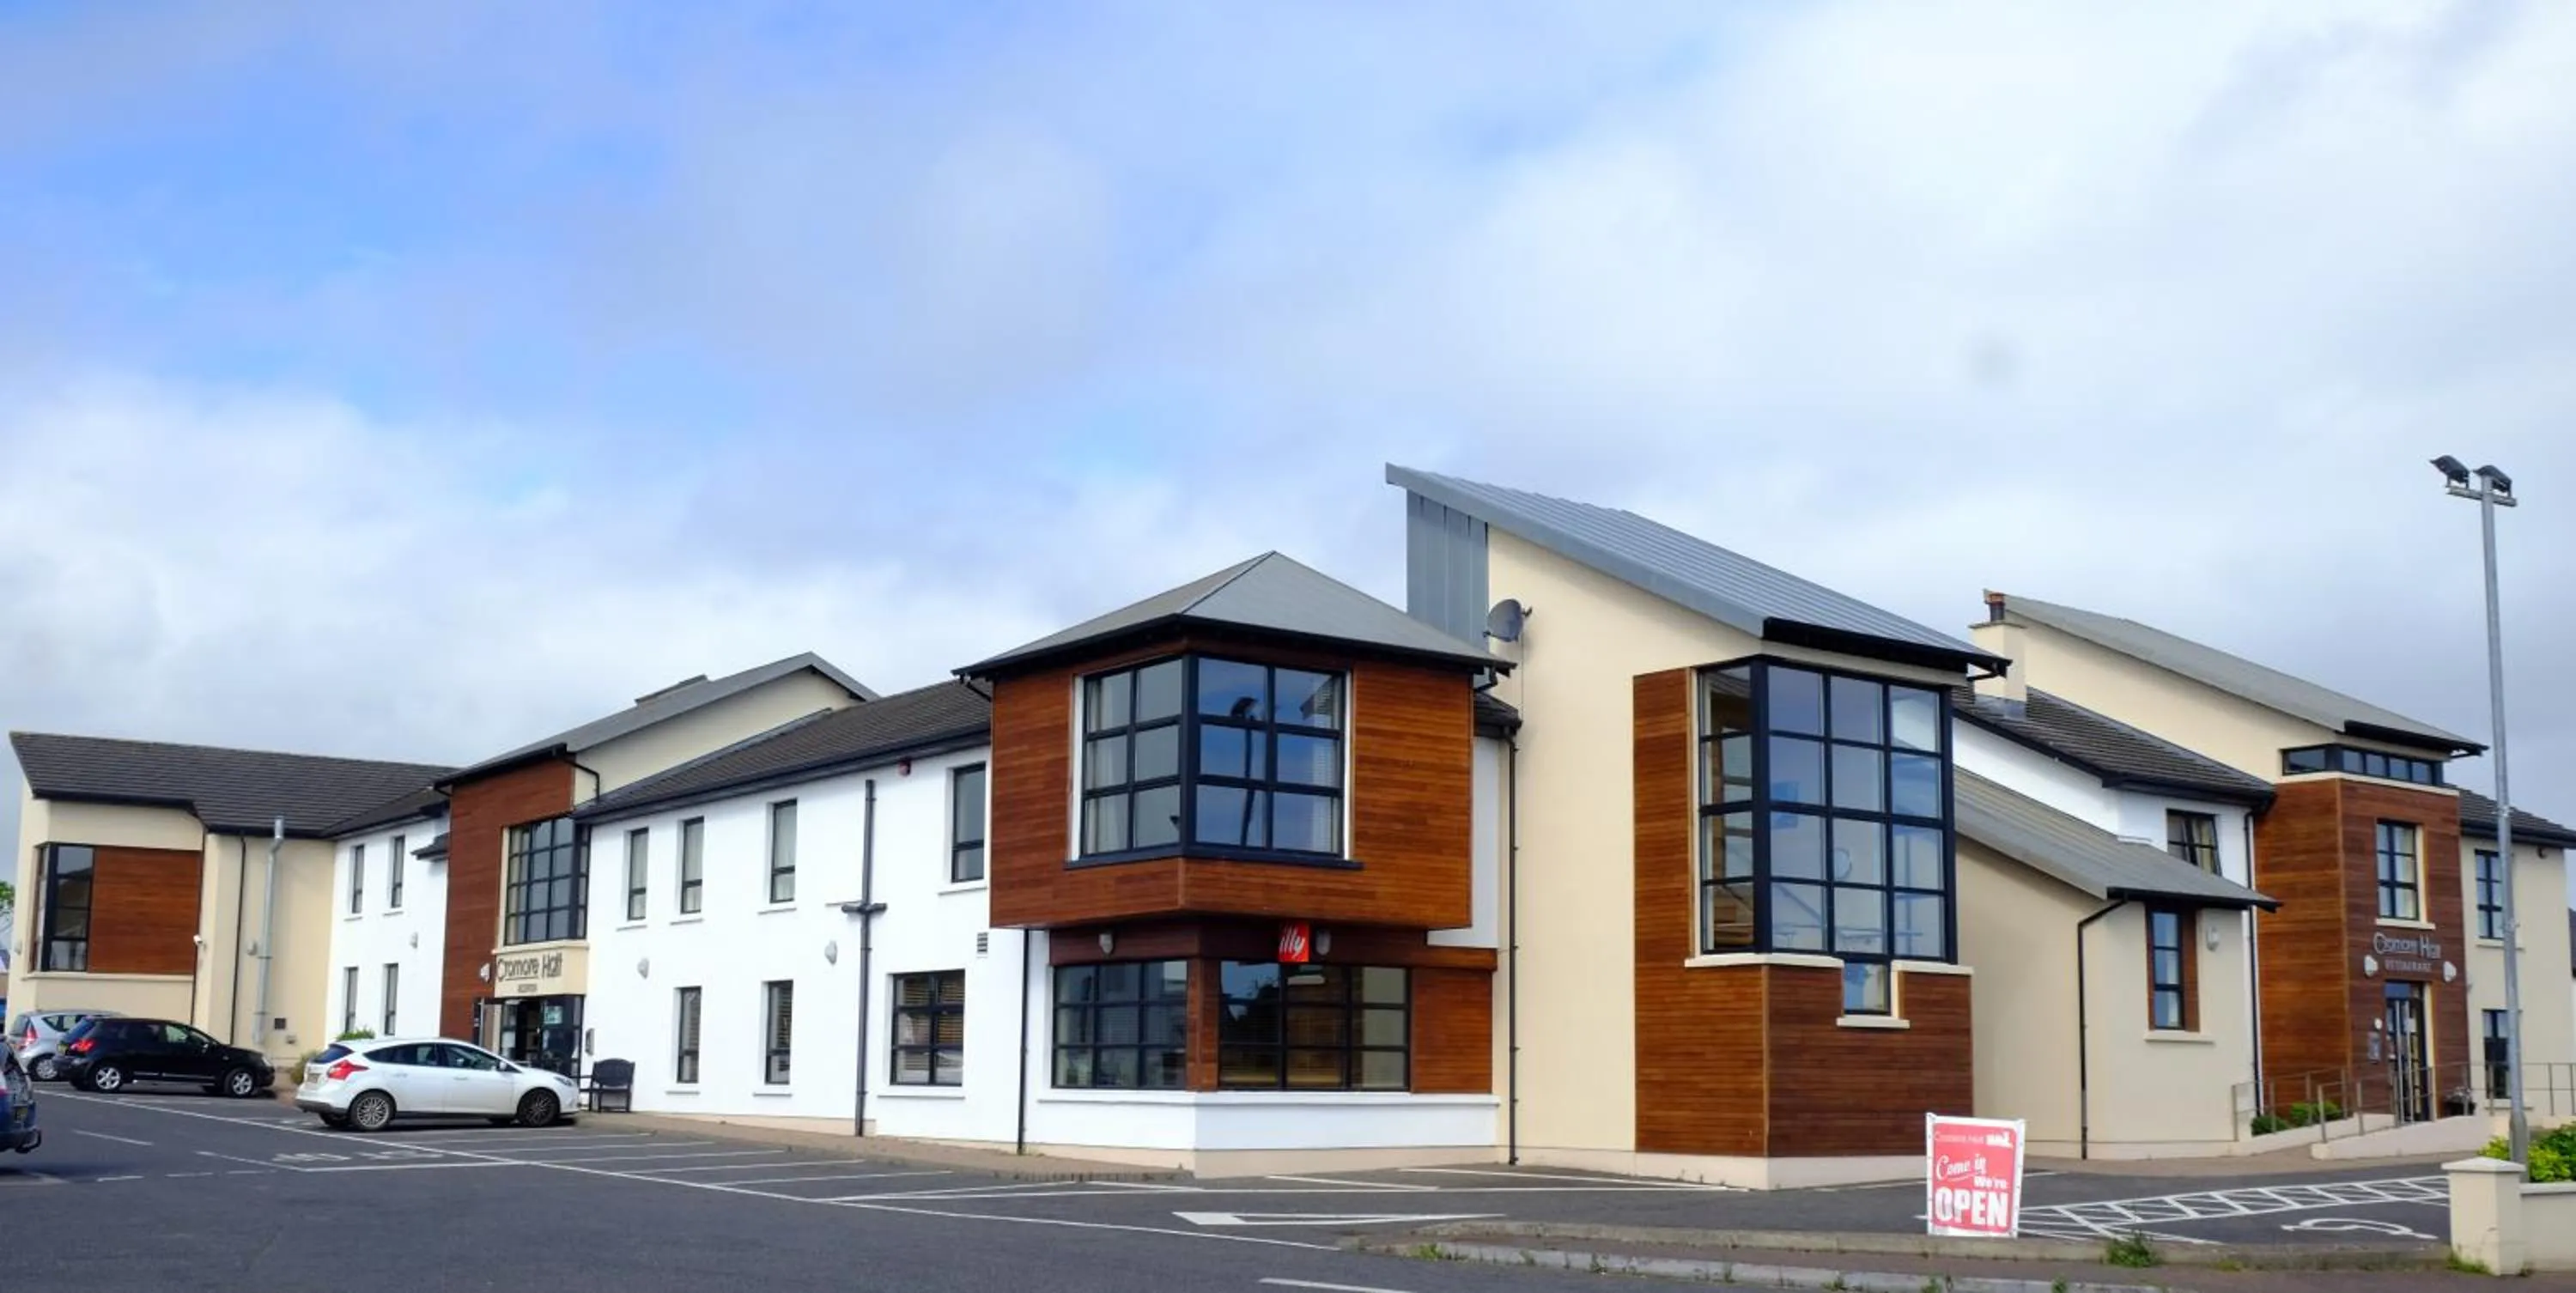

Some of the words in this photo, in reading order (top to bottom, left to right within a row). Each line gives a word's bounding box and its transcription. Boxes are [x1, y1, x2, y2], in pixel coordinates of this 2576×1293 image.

[1279, 926, 1306, 960] illy
[1936, 1155, 1971, 1181] Come
[1935, 1186, 2010, 1228] OPEN
